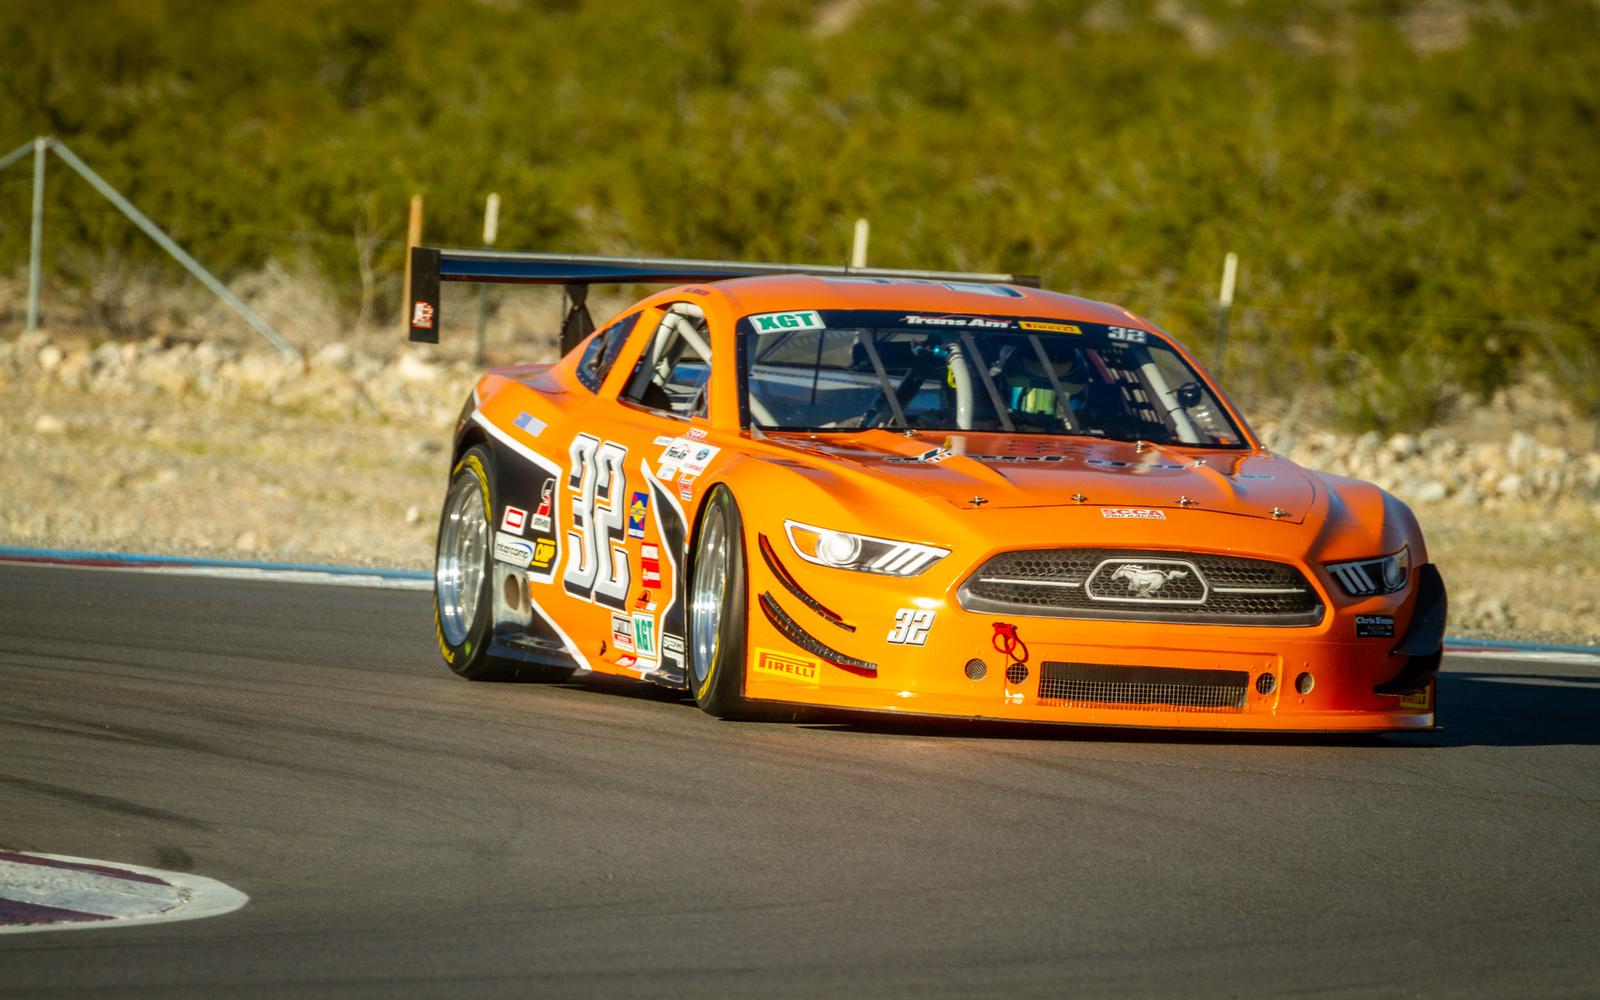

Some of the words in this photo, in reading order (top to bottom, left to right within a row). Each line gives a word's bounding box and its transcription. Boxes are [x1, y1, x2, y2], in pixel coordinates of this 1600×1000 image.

[757, 313, 814, 330] XGT
[905, 316, 966, 326] Trans
[968, 318, 1008, 328] Am
[1107, 326, 1146, 343] 32
[564, 432, 630, 612] 32
[635, 618, 654, 652] XGT
[887, 608, 935, 646] 32
[759, 652, 816, 679] PIRELLI
